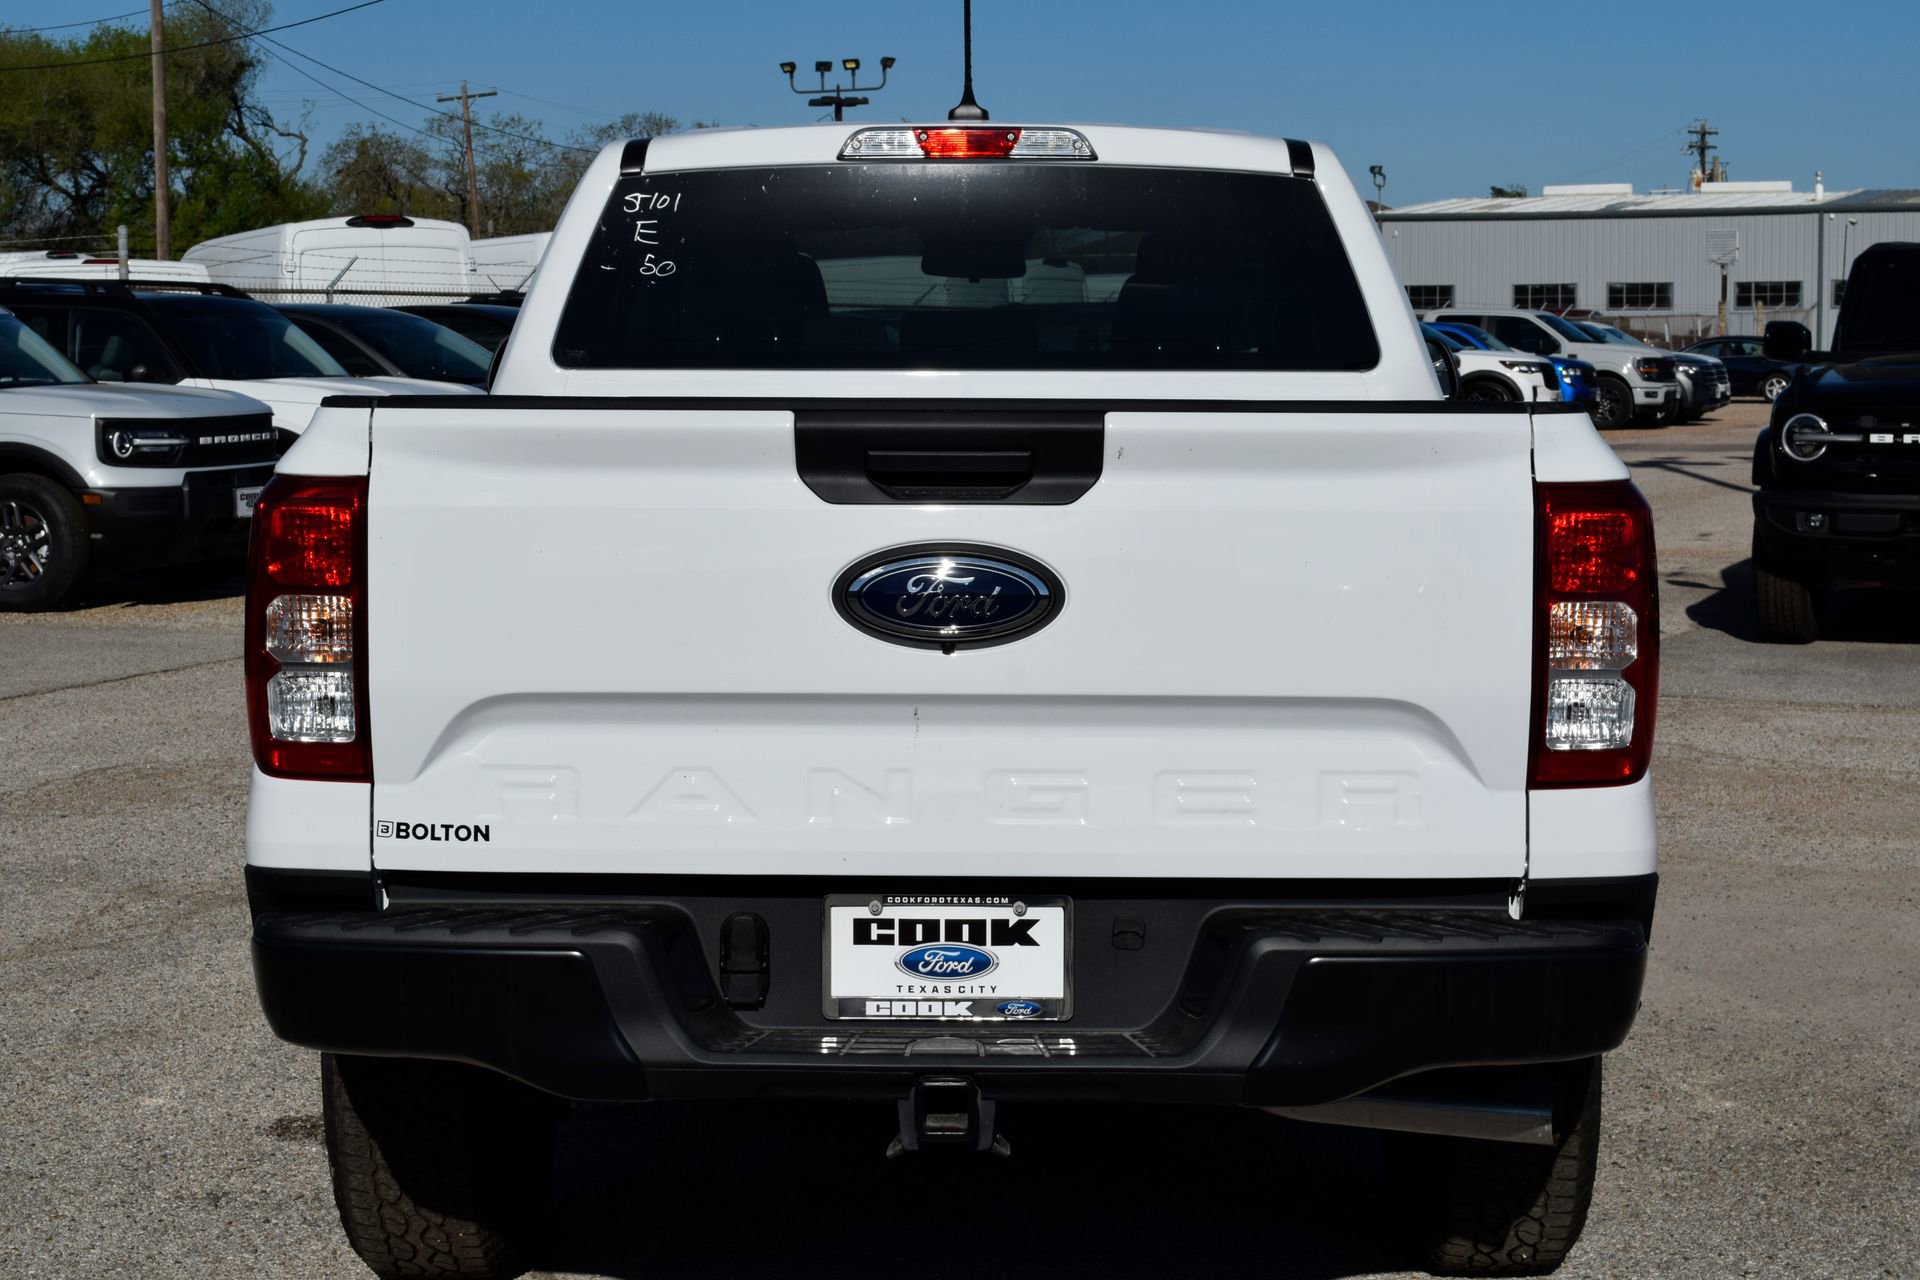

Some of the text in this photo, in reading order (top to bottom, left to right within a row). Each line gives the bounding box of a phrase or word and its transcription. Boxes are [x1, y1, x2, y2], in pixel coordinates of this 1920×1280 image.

[634, 220, 659, 245] E
[640, 254, 676, 277] 50
[896, 574, 1001, 619] Ford
[478, 764, 1423, 826] RANGER
[395, 822, 490, 842] BOLTON
[887, 896, 1009, 904] COOKFORDTEXAS.COM
[853, 918, 1041, 947] COOK
[918, 949, 974, 974] Ford
[865, 1001, 1032, 1016] COOK Ford
